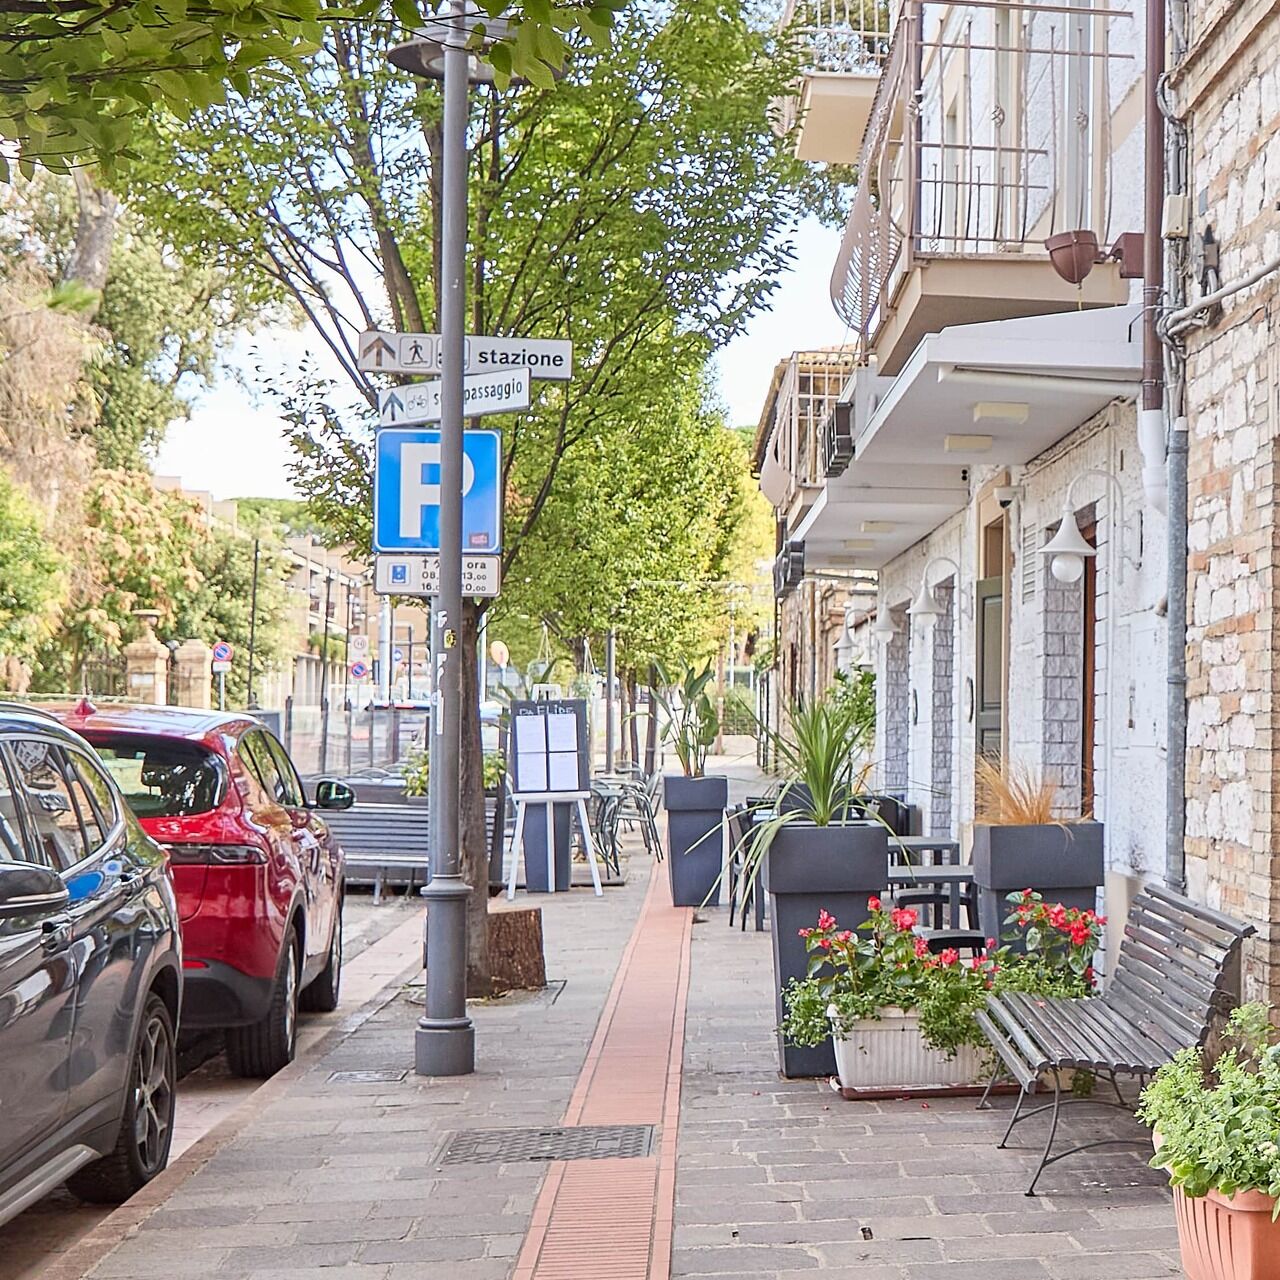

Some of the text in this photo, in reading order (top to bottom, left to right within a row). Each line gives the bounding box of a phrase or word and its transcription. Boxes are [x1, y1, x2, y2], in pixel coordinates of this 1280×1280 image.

[478, 348, 565, 368] stazione
[399, 442, 475, 539] P
[462, 583, 487, 592] 0.00
